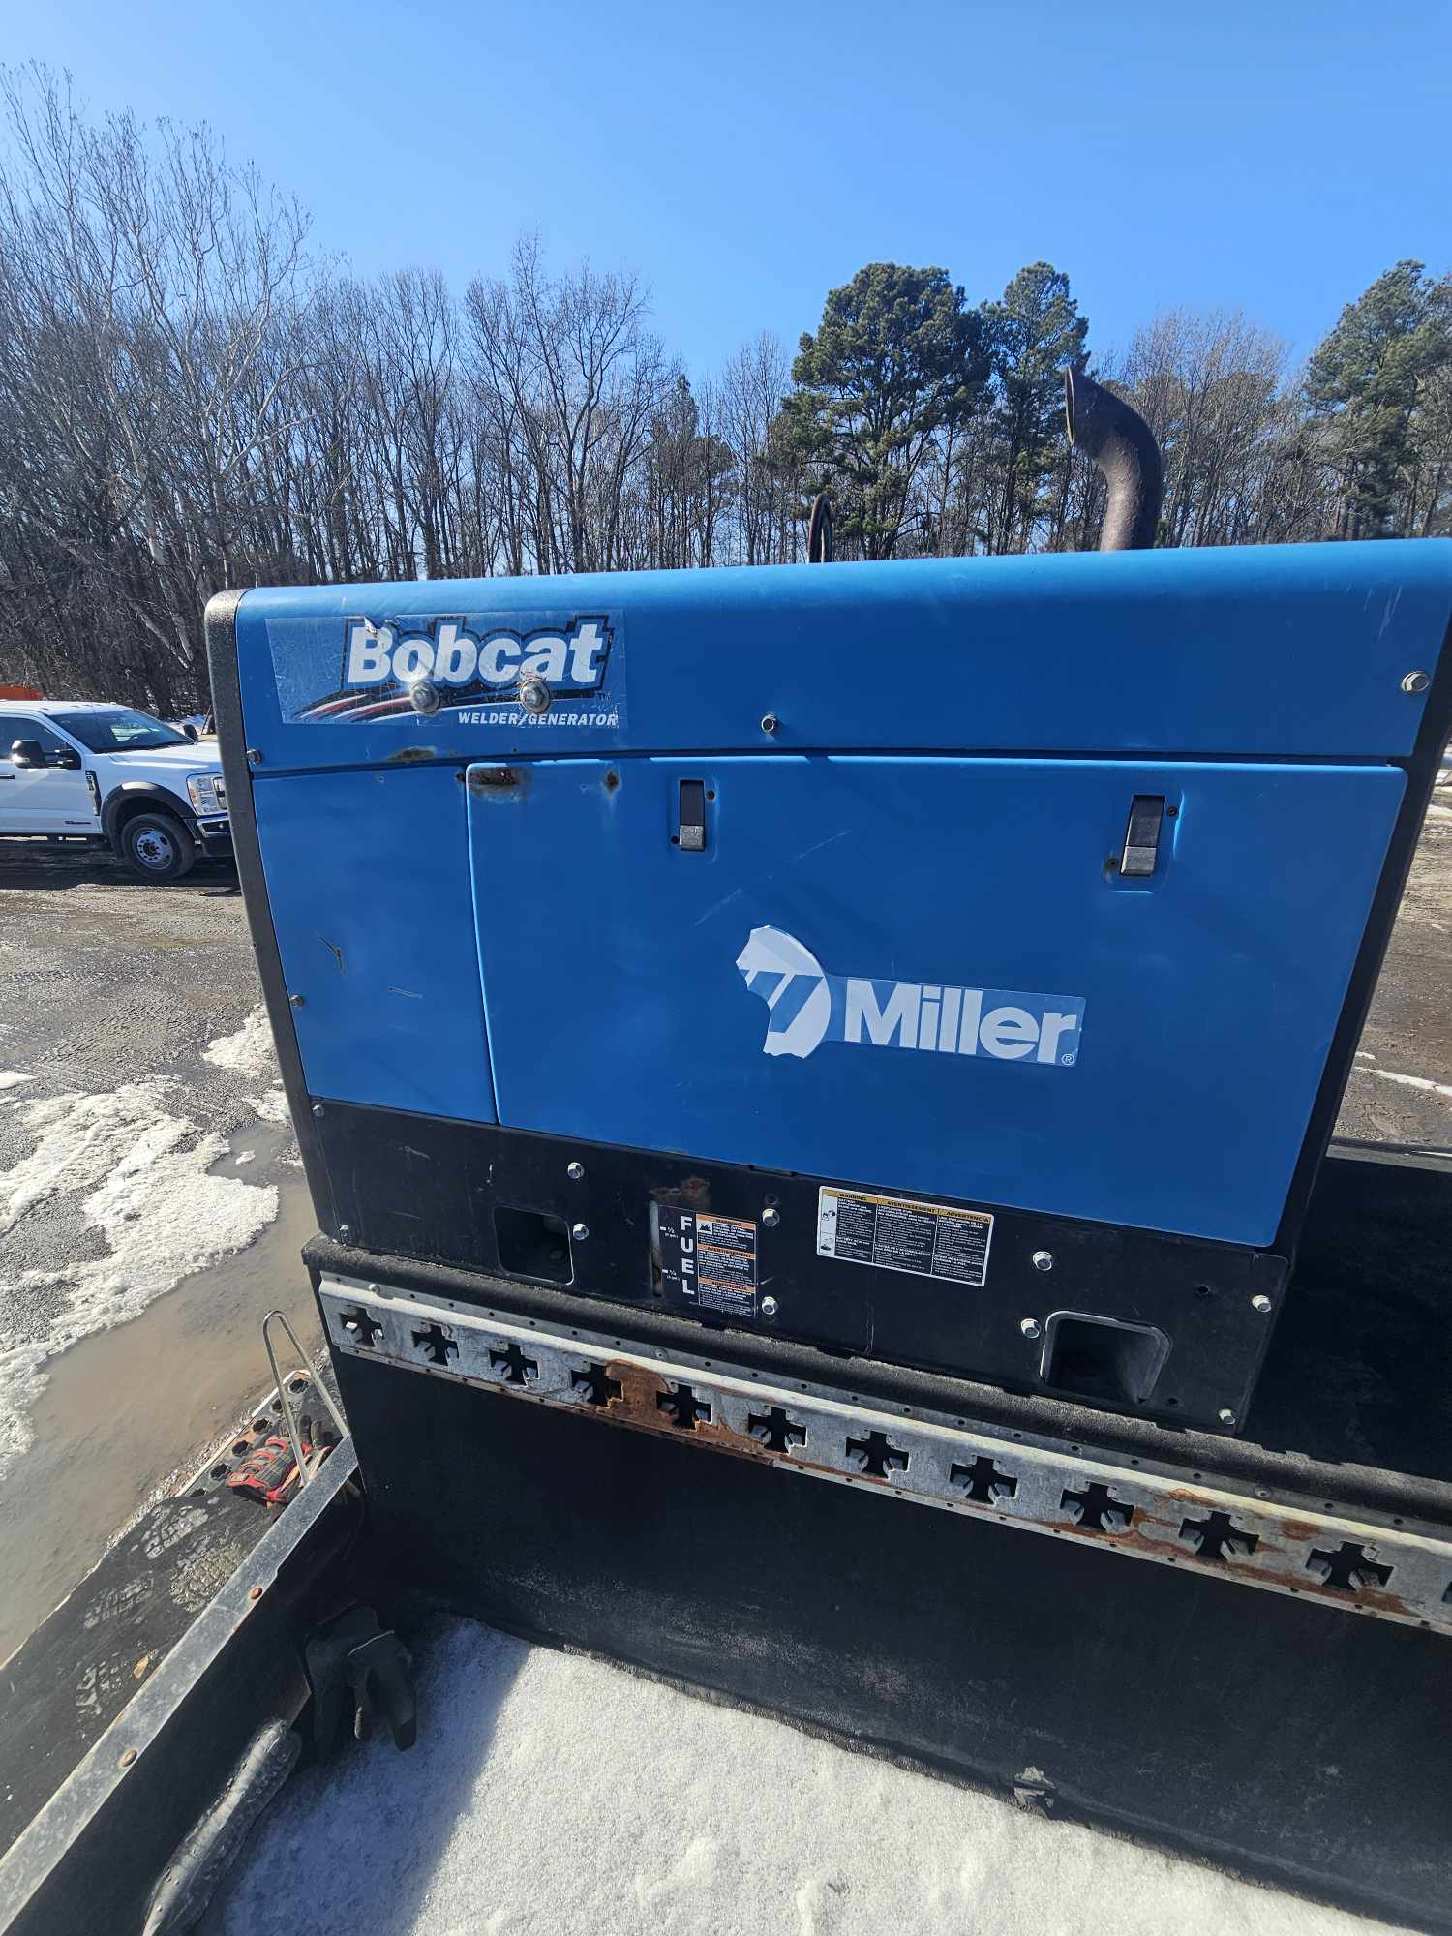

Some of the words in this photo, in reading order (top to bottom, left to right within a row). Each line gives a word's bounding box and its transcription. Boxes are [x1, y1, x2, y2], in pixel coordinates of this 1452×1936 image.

[347, 623, 605, 683] Bobcat
[457, 711, 619, 727] WELDER/GENERATOR
[844, 979, 1080, 1064] Miller
[680, 1215, 696, 1295] FUEL
